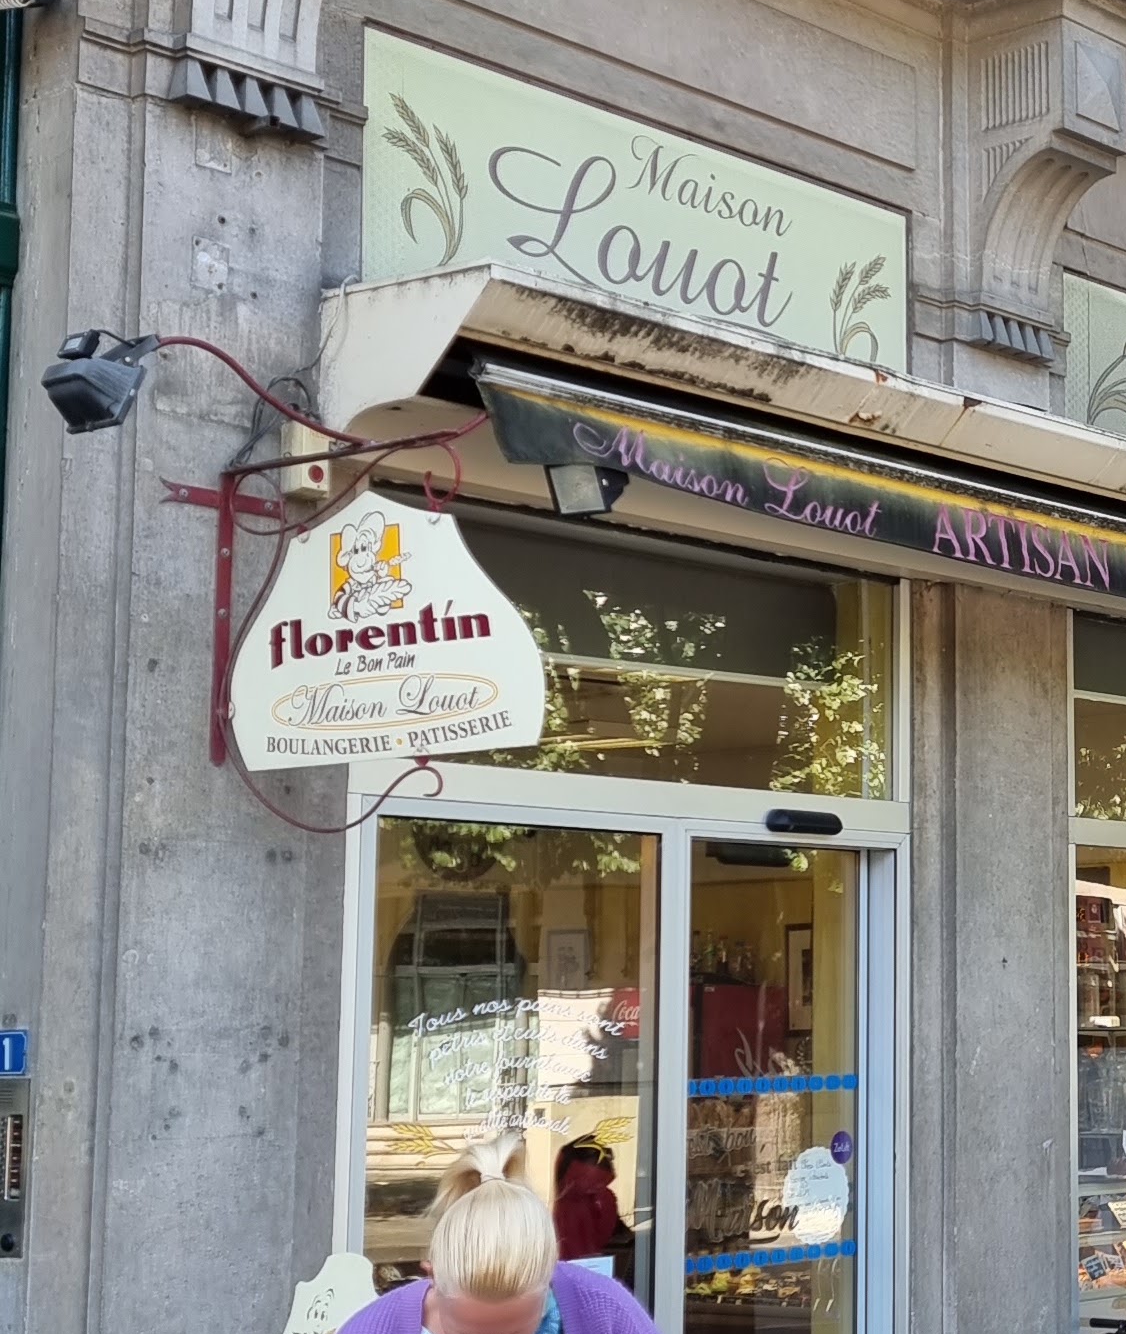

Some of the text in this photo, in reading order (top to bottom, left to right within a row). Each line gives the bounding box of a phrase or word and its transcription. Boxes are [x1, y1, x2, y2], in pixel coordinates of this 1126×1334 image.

[631, 133, 793, 237] Maison
[489, 145, 793, 328] Louot
[571, 419, 749, 507] Maison
[762, 456, 883, 538] Louot
[932, 503, 1111, 590] ARTISAN
[269, 601, 491, 670] florentin
[334, 650, 417, 677] Le Bon Pain
[287, 674, 481, 727] Maison Louot
[266, 710, 513, 756] BOULANGERIE PATISSERIE
[408, 1007, 466, 1038] Tous
[472, 998, 514, 1016] nos
